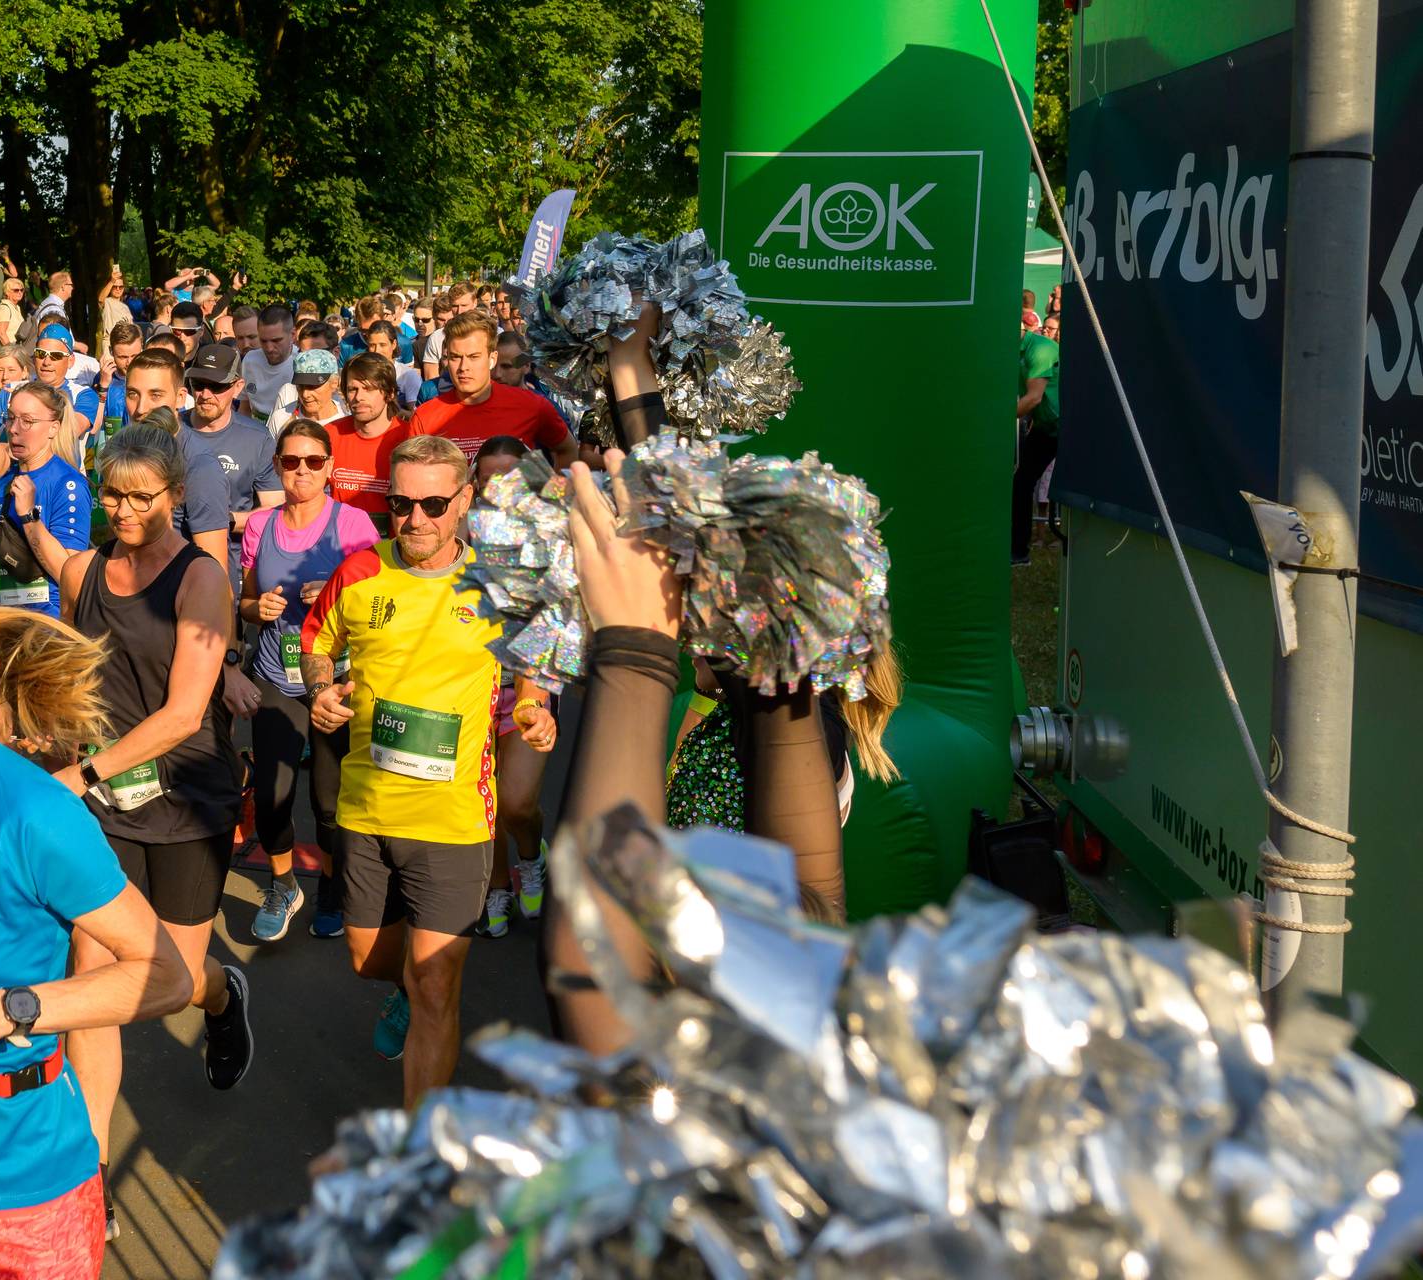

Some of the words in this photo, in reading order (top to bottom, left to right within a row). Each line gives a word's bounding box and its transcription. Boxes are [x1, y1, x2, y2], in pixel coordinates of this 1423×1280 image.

[753, 181, 938, 251] AOK
[1115, 144, 1279, 320] erfolg.
[748, 252, 771, 269] Die
[775, 254, 938, 272] Gesundheitskasse.
[1375, 489, 1397, 508] JANA
[368, 595, 381, 630] Maratón
[1070, 660, 1080, 686] 80
[377, 713, 407, 733] Jörg
[377, 727, 395, 742] 173
[426, 764, 443, 773] AOK
[130, 791, 148, 801] AOK
